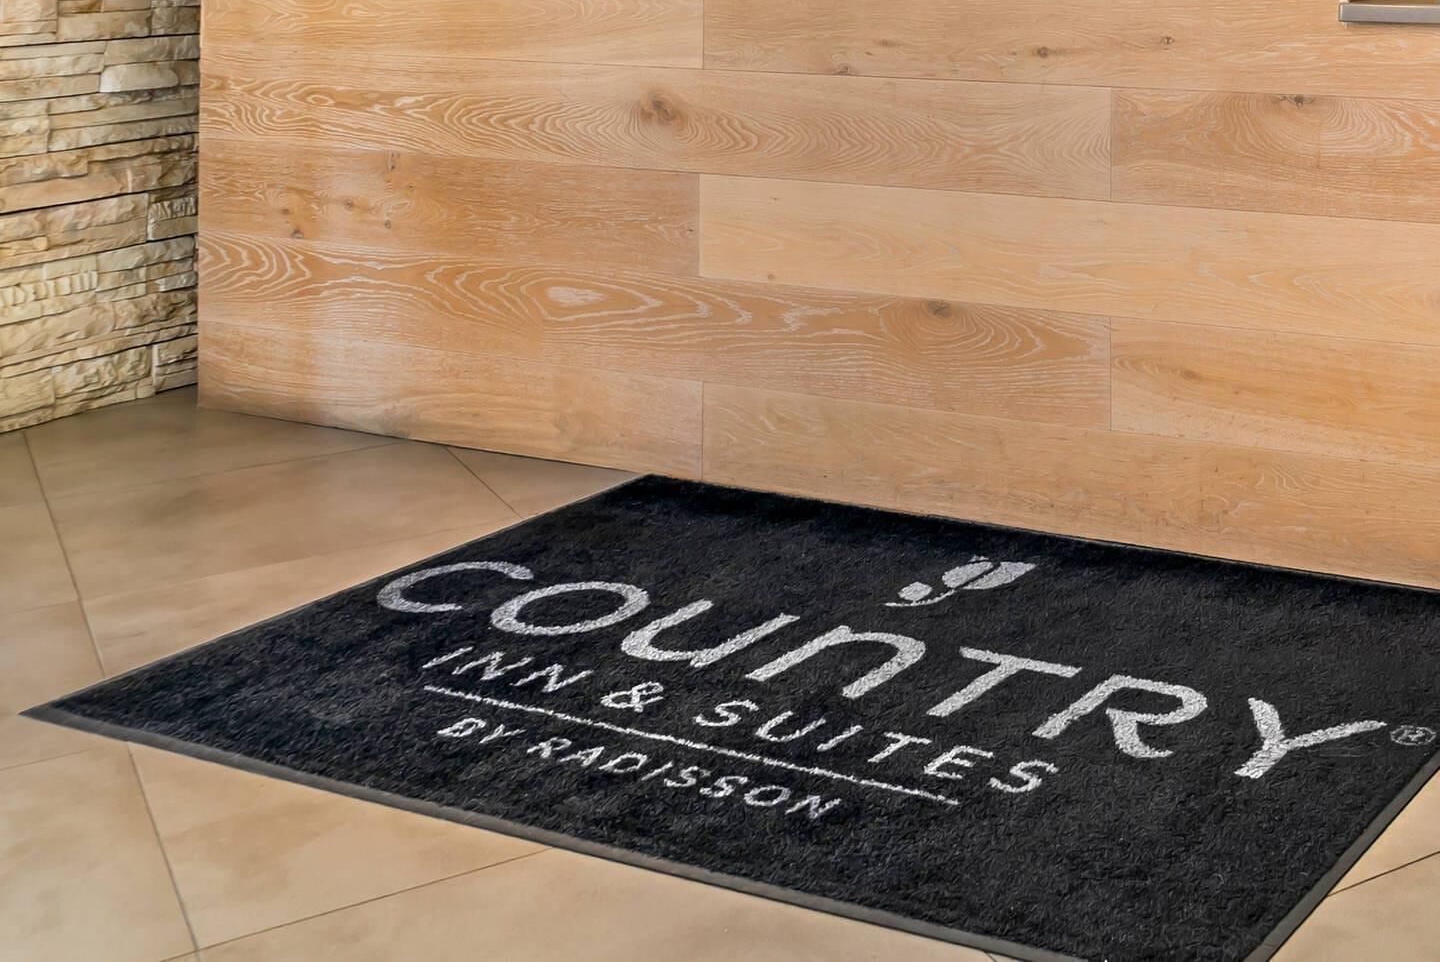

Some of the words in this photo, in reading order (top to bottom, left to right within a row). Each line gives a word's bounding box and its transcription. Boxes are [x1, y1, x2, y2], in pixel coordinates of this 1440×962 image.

[422, 646, 594, 693] INN
[600, 681, 664, 713] &
[693, 699, 1059, 793] SUITES
[436, 717, 527, 744] BY
[527, 738, 841, 819] RADISSON
